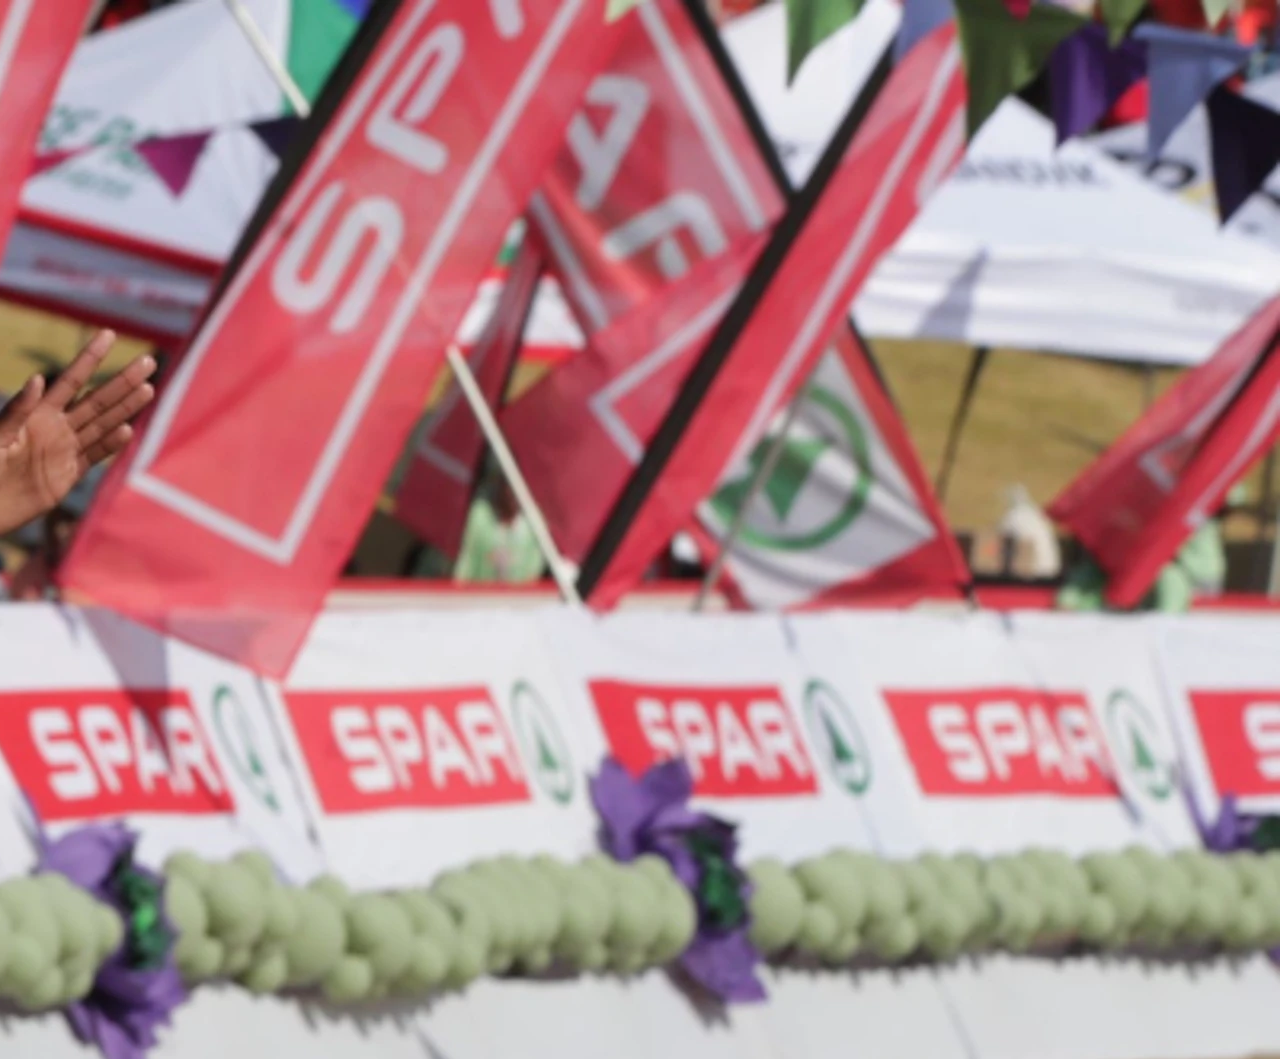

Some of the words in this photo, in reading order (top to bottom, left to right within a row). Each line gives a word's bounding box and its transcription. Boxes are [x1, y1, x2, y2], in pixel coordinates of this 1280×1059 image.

[27, 703, 220, 800] SPAR
[329, 699, 525, 793] SPAR
[926, 706, 1110, 783] SPAR
